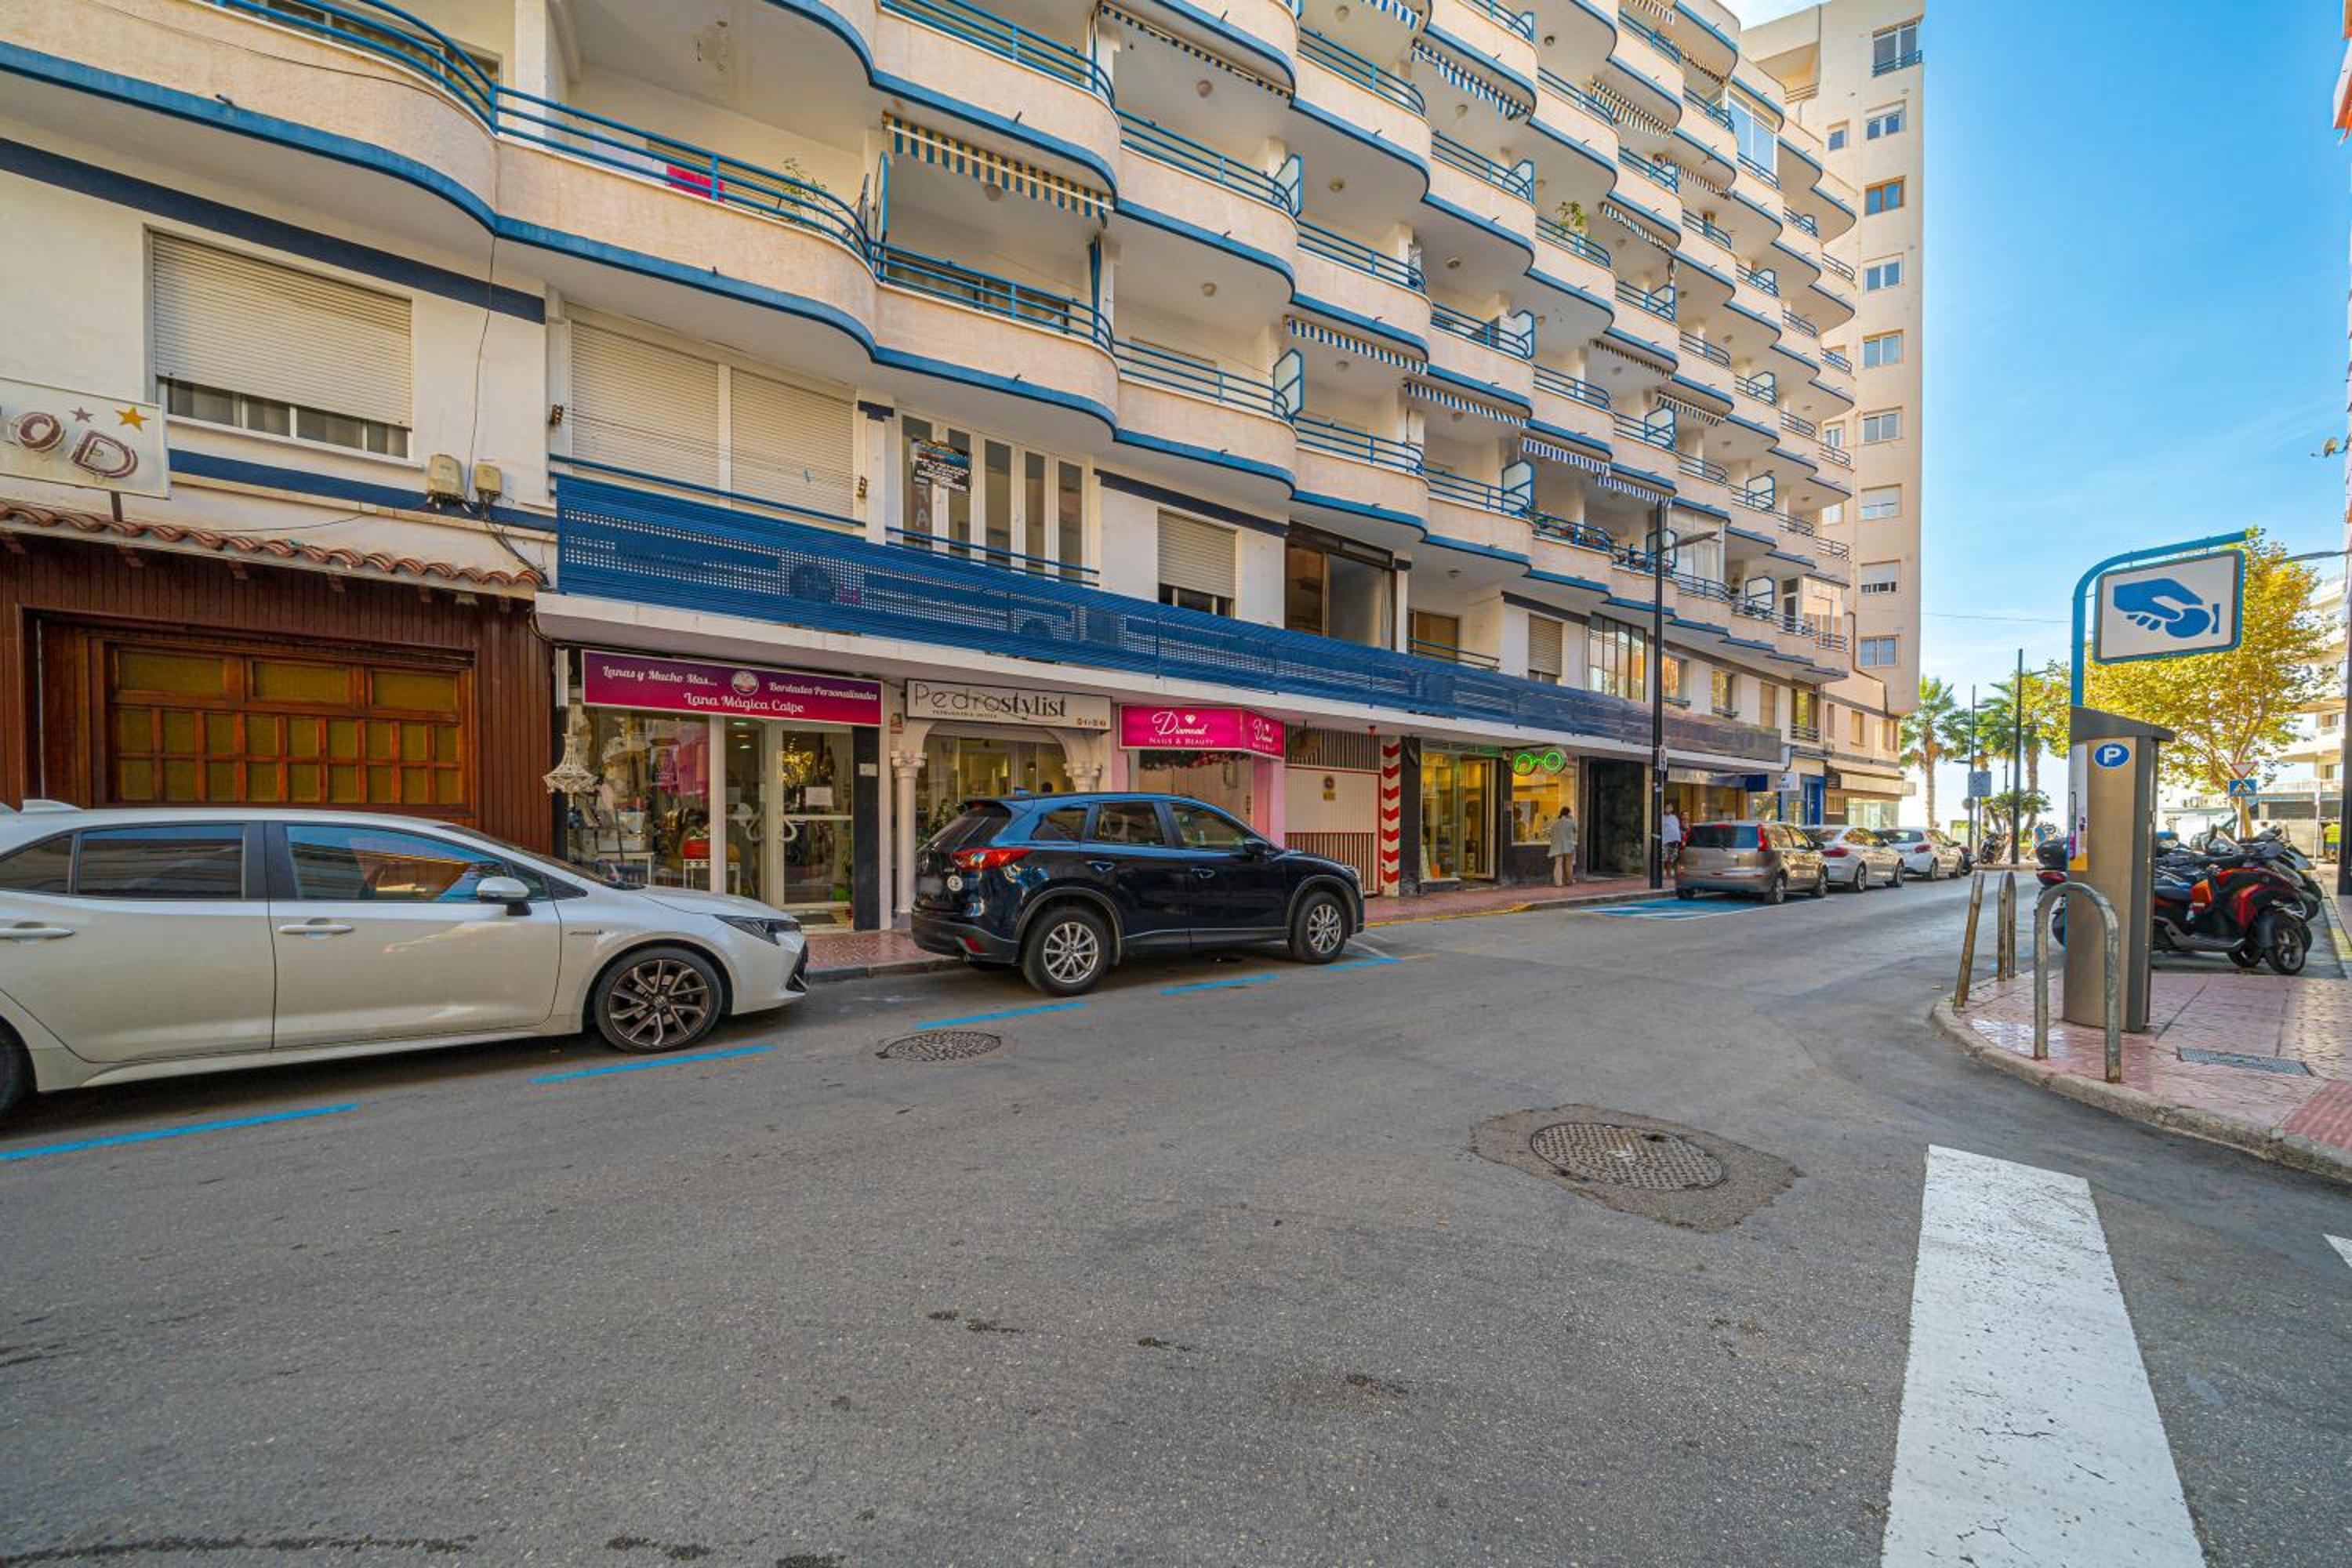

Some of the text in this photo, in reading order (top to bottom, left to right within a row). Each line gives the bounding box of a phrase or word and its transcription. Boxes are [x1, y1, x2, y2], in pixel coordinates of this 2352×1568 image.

[0, 406, 138, 477] OD
[603, 666, 635, 680] Lanas
[637, 671, 644, 681] y
[648, 670, 683, 683] Mucho
[684, 692, 719, 706] Lana
[771, 699, 804, 714] Calpe
[1152, 711, 1208, 735] Diamond
[2103, 747, 2122, 764] P
